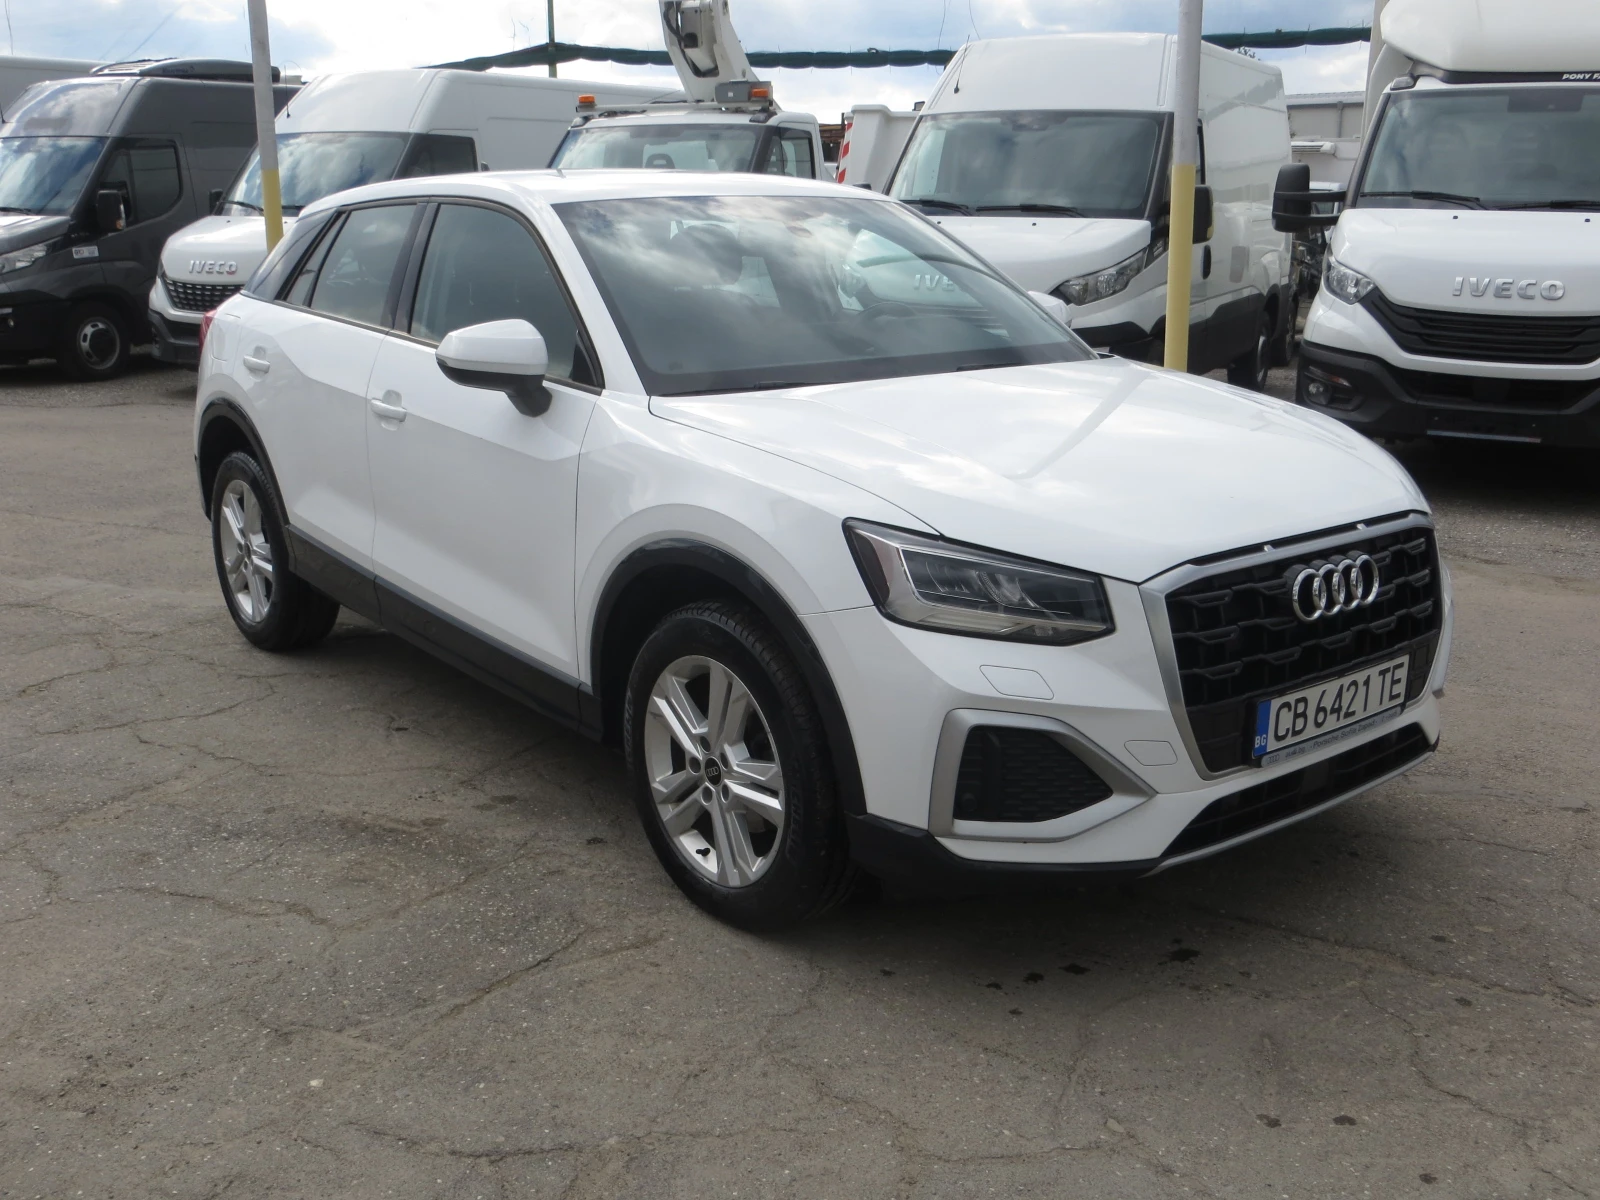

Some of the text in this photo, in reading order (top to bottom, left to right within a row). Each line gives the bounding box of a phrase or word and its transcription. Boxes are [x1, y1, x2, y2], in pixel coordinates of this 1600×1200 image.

[189, 260, 238, 275] IVECO
[1452, 276, 1565, 301] IVECO
[1274, 661, 1405, 742] CB 6421 TE
[1255, 734, 1267, 748] BG
